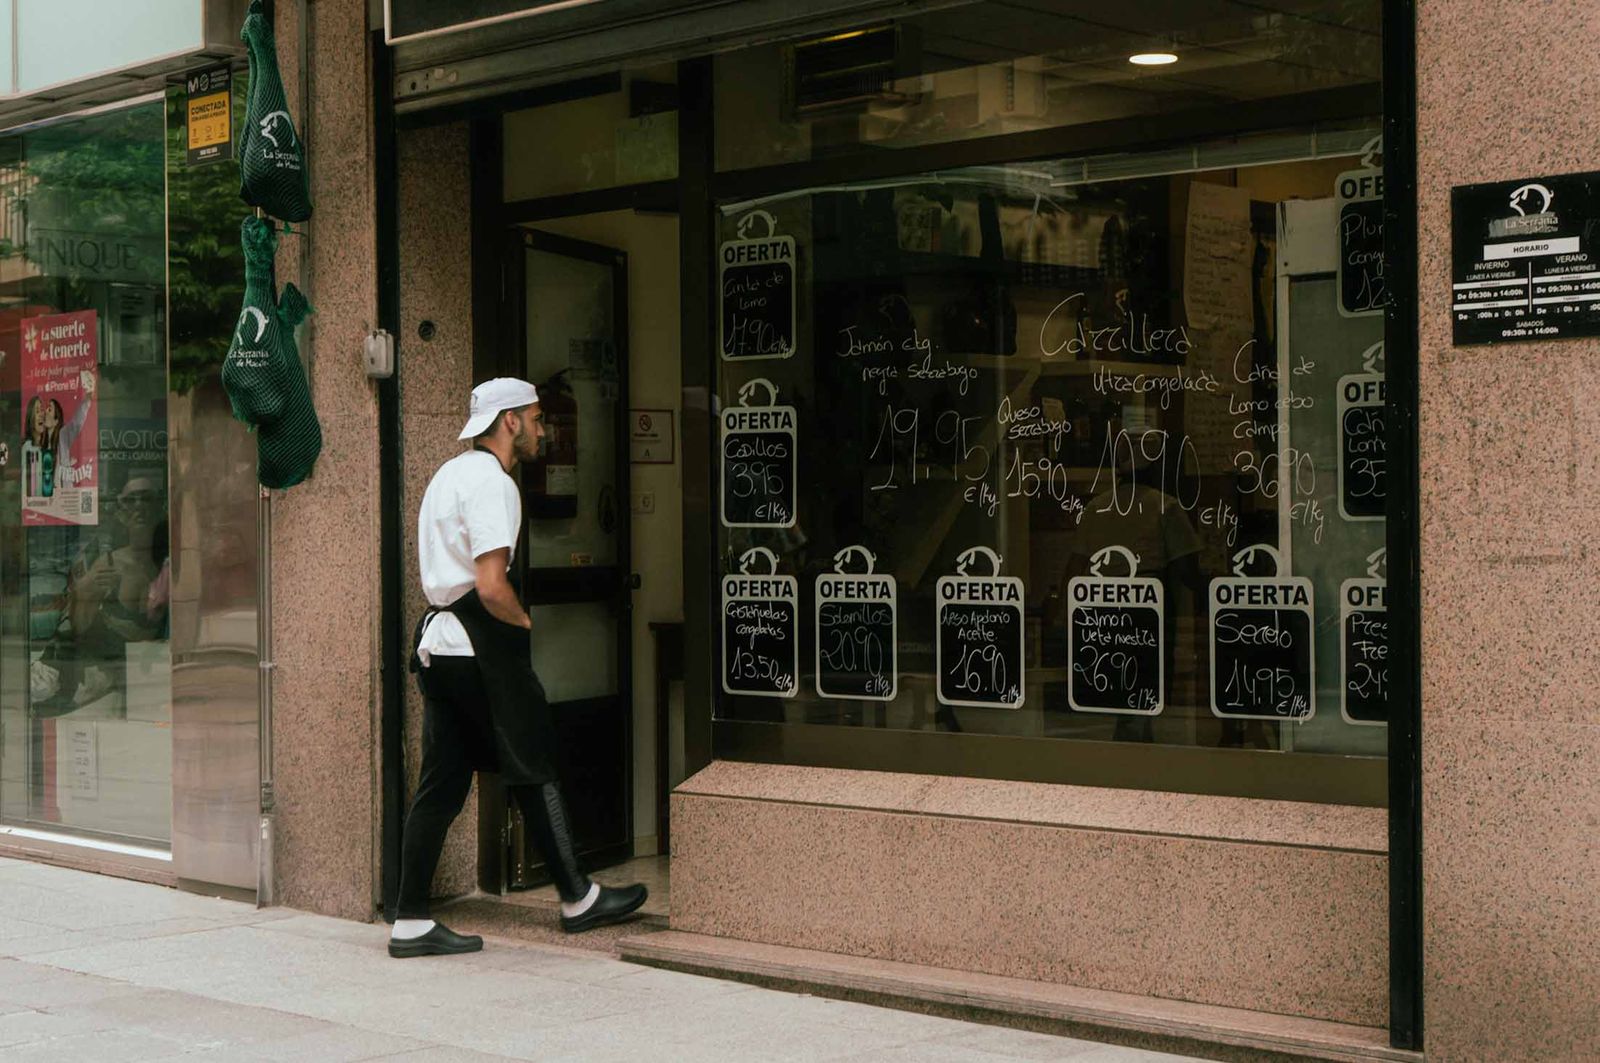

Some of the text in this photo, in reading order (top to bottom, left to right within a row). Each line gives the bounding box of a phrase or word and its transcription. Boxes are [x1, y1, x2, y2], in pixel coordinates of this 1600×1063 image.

[191, 101, 226, 116] CONECTADA
[724, 241, 791, 264] OFERTA
[1513, 244, 1549, 253] HORARIO
[1474, 260, 1510, 271] INVIERNO
[1555, 253, 1588, 264] VERANO
[1466, 273, 1486, 281] LUNES
[1491, 271, 1516, 279] VIERNES
[1544, 266, 1564, 275] LUNES
[1570, 264, 1597, 272] VIERNES
[1500, 288, 1523, 297] 14:00h
[1536, 286, 1547, 294] De
[1536, 307, 1547, 315] De
[41, 319, 86, 341] La suerte
[1502, 329, 1527, 337] 09:30h
[1534, 327, 1559, 335] 14:00h
[40, 339, 91, 360] de tenerte
[1233, 339, 1315, 384] Caña de
[997, 395, 1040, 424] Queso
[725, 411, 793, 430] OFERTA
[726, 580, 794, 597] OFERTA
[820, 581, 891, 599] OFERTA
[942, 582, 1020, 601] OFERTA
[1074, 583, 1158, 603] OFERTA
[1216, 585, 1309, 605] OFERTA
